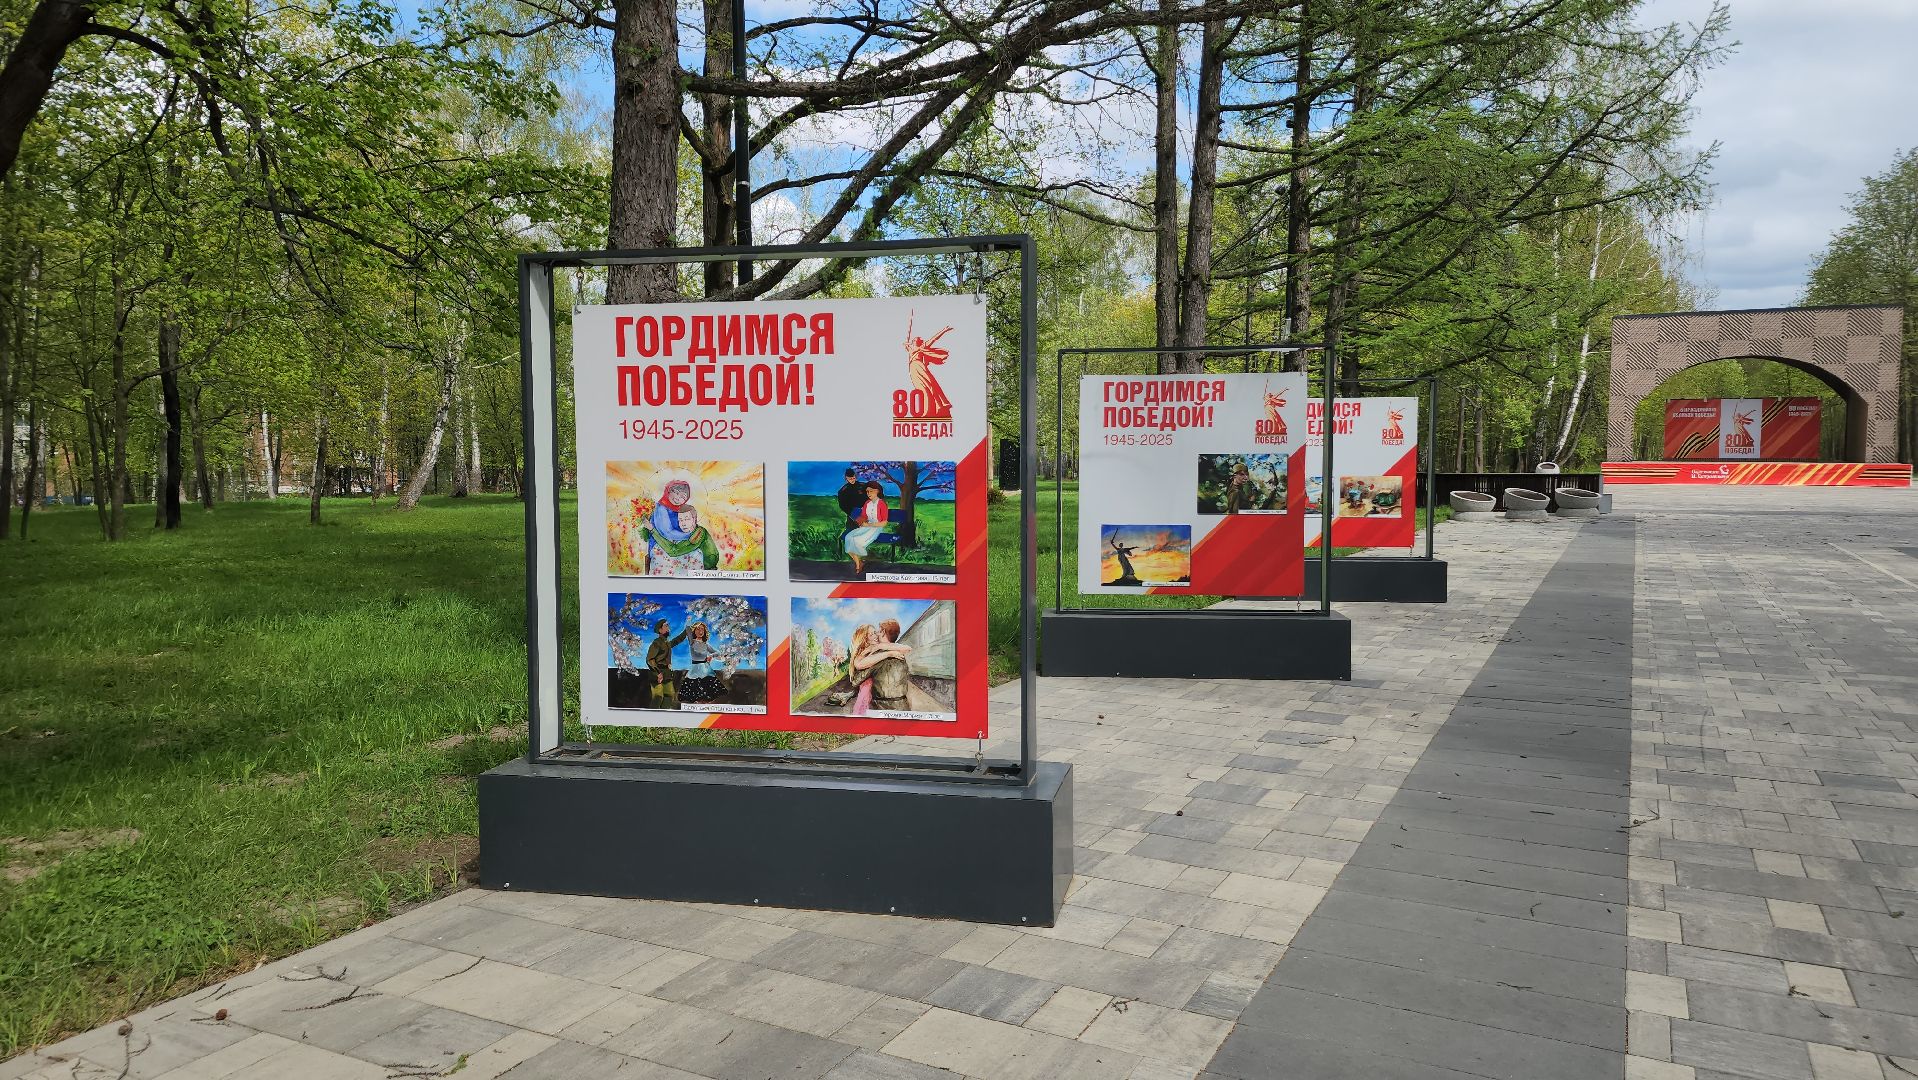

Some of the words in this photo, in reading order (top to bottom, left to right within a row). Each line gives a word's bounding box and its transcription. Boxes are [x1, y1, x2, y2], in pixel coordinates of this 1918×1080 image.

[615, 313, 835, 363] ГОРДИМСЯ
[617, 356, 816, 412] ПОБЕДОЙ!
[1103, 380, 1226, 406] ГОРДИМСЯ
[892, 389, 925, 418] 80
[1103, 402, 1214, 432] ПОБЕДОЙ!
[1255, 419, 1273, 435] 80
[619, 419, 744, 440] 1945-2025
[892, 422, 954, 440] ПОБЕДА!
[1103, 434, 1173, 446] 1945-2025
[1255, 436, 1288, 445] ПОБЕДА!
[1725, 434, 1741, 447] 80
